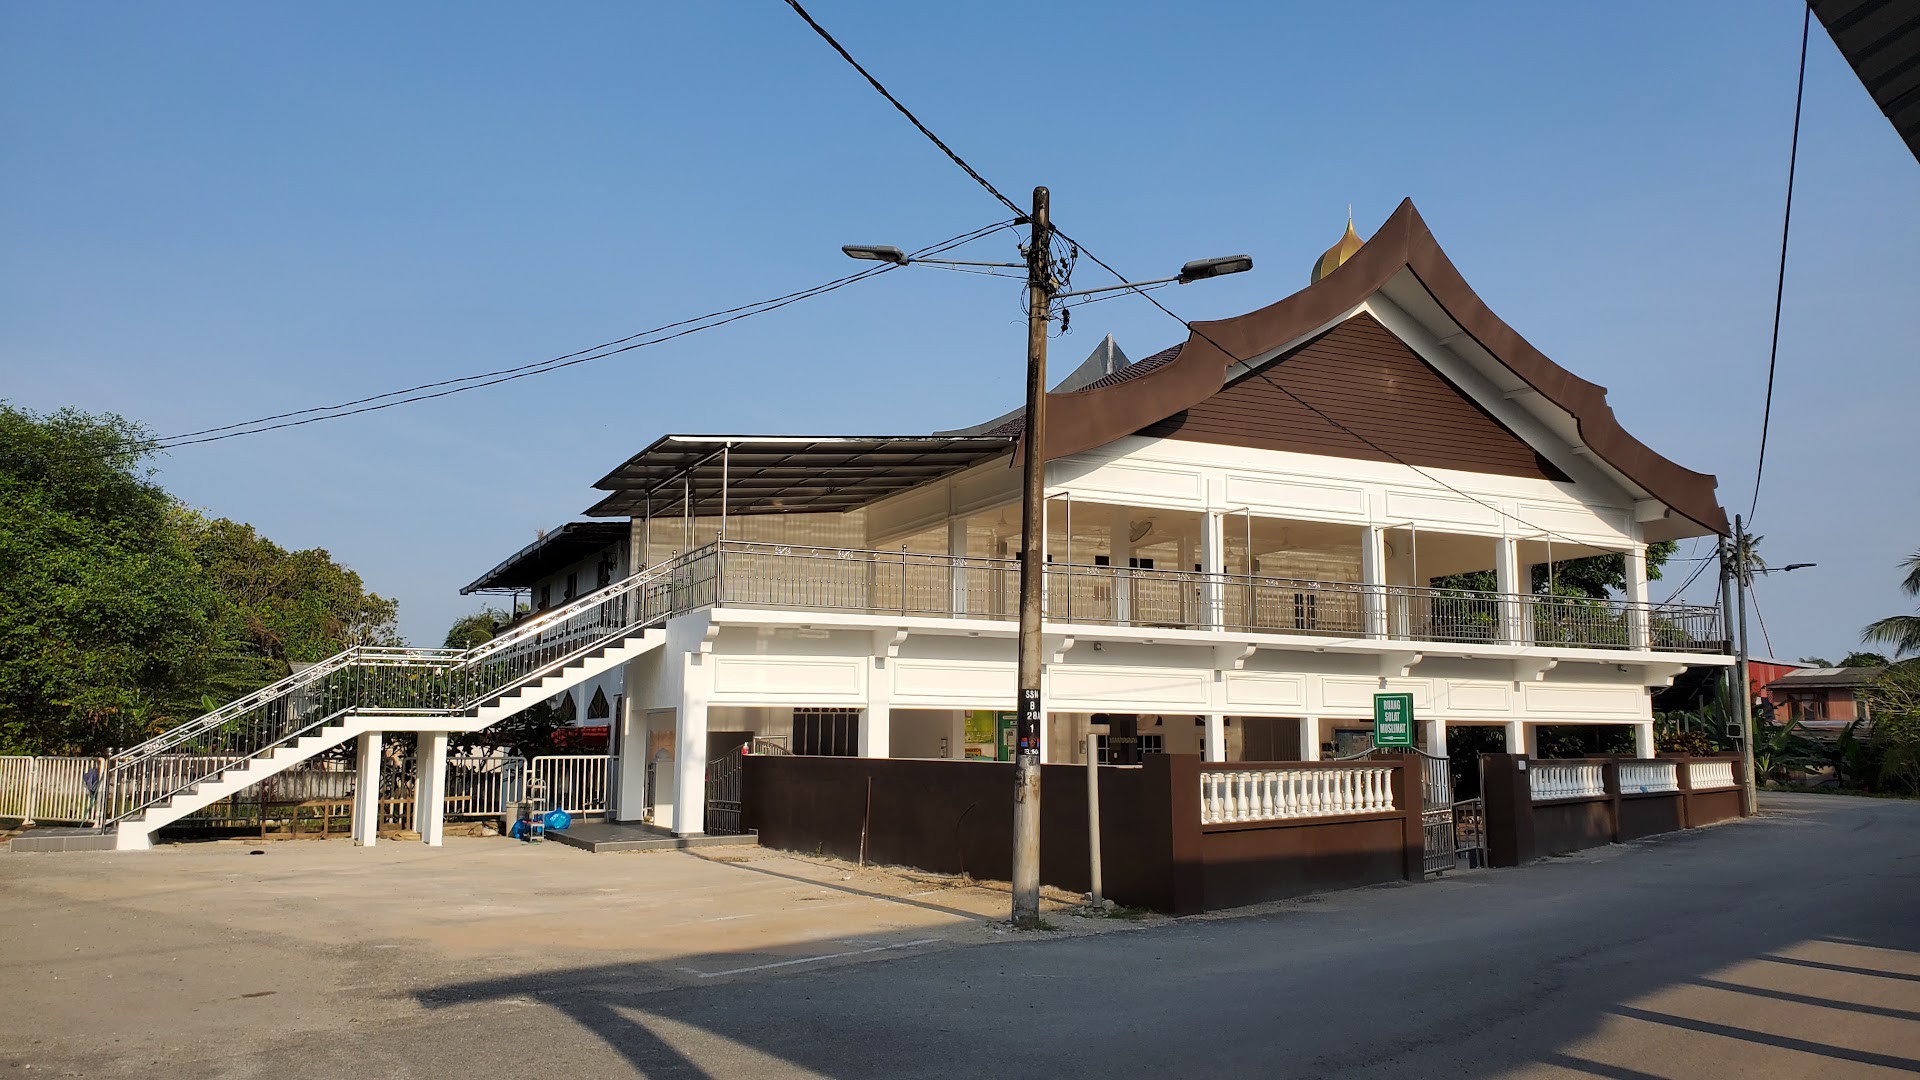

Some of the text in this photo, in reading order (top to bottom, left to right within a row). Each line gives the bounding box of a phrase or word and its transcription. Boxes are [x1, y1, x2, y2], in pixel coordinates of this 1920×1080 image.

[1383, 700, 1400, 710] RUANG
[1385, 712, 1400, 722] SOLAT
[1030, 724, 1034, 733] 1
[1380, 723, 1406, 734] MUSLIMAT
